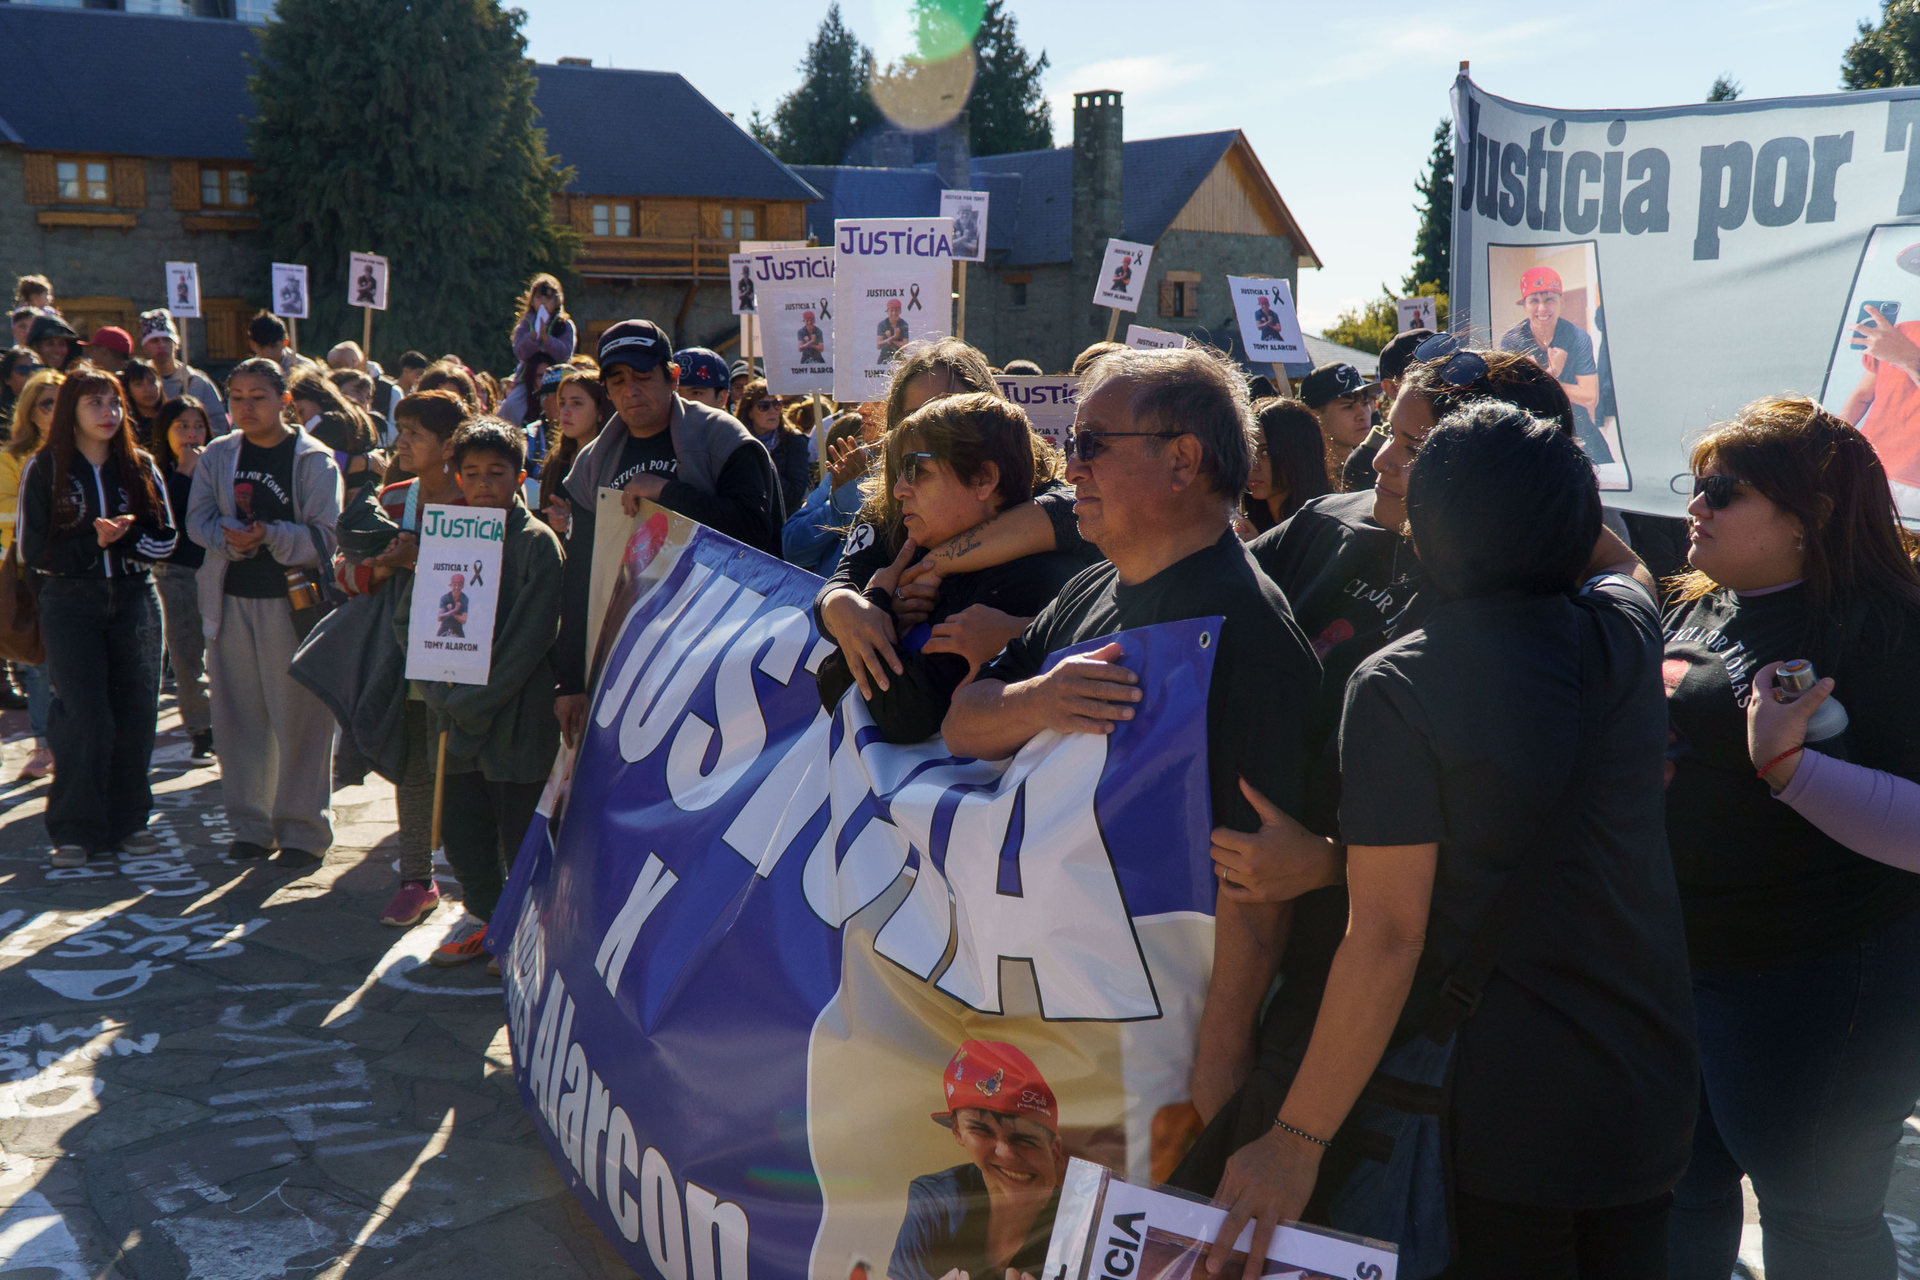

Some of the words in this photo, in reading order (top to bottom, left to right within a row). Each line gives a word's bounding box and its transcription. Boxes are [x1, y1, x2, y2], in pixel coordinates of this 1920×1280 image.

[1460, 92, 1670, 236] Justicia
[1693, 130, 1855, 261] por
[866, 289, 897, 298] JUSTICIA
[899, 289, 905, 297] X
[1240, 288, 1264, 296] JUSTICIA
[784, 303, 810, 311] JUSTICIA
[1252, 343, 1269, 351] TOMY
[433, 562, 462, 572] JUSTICIA
[463, 563, 469, 572] X
[424, 640, 444, 650] TOMY
[445, 640, 478, 652] ALARCON
[594, 851, 680, 998] X
[529, 968, 749, 1280] Alarcon
